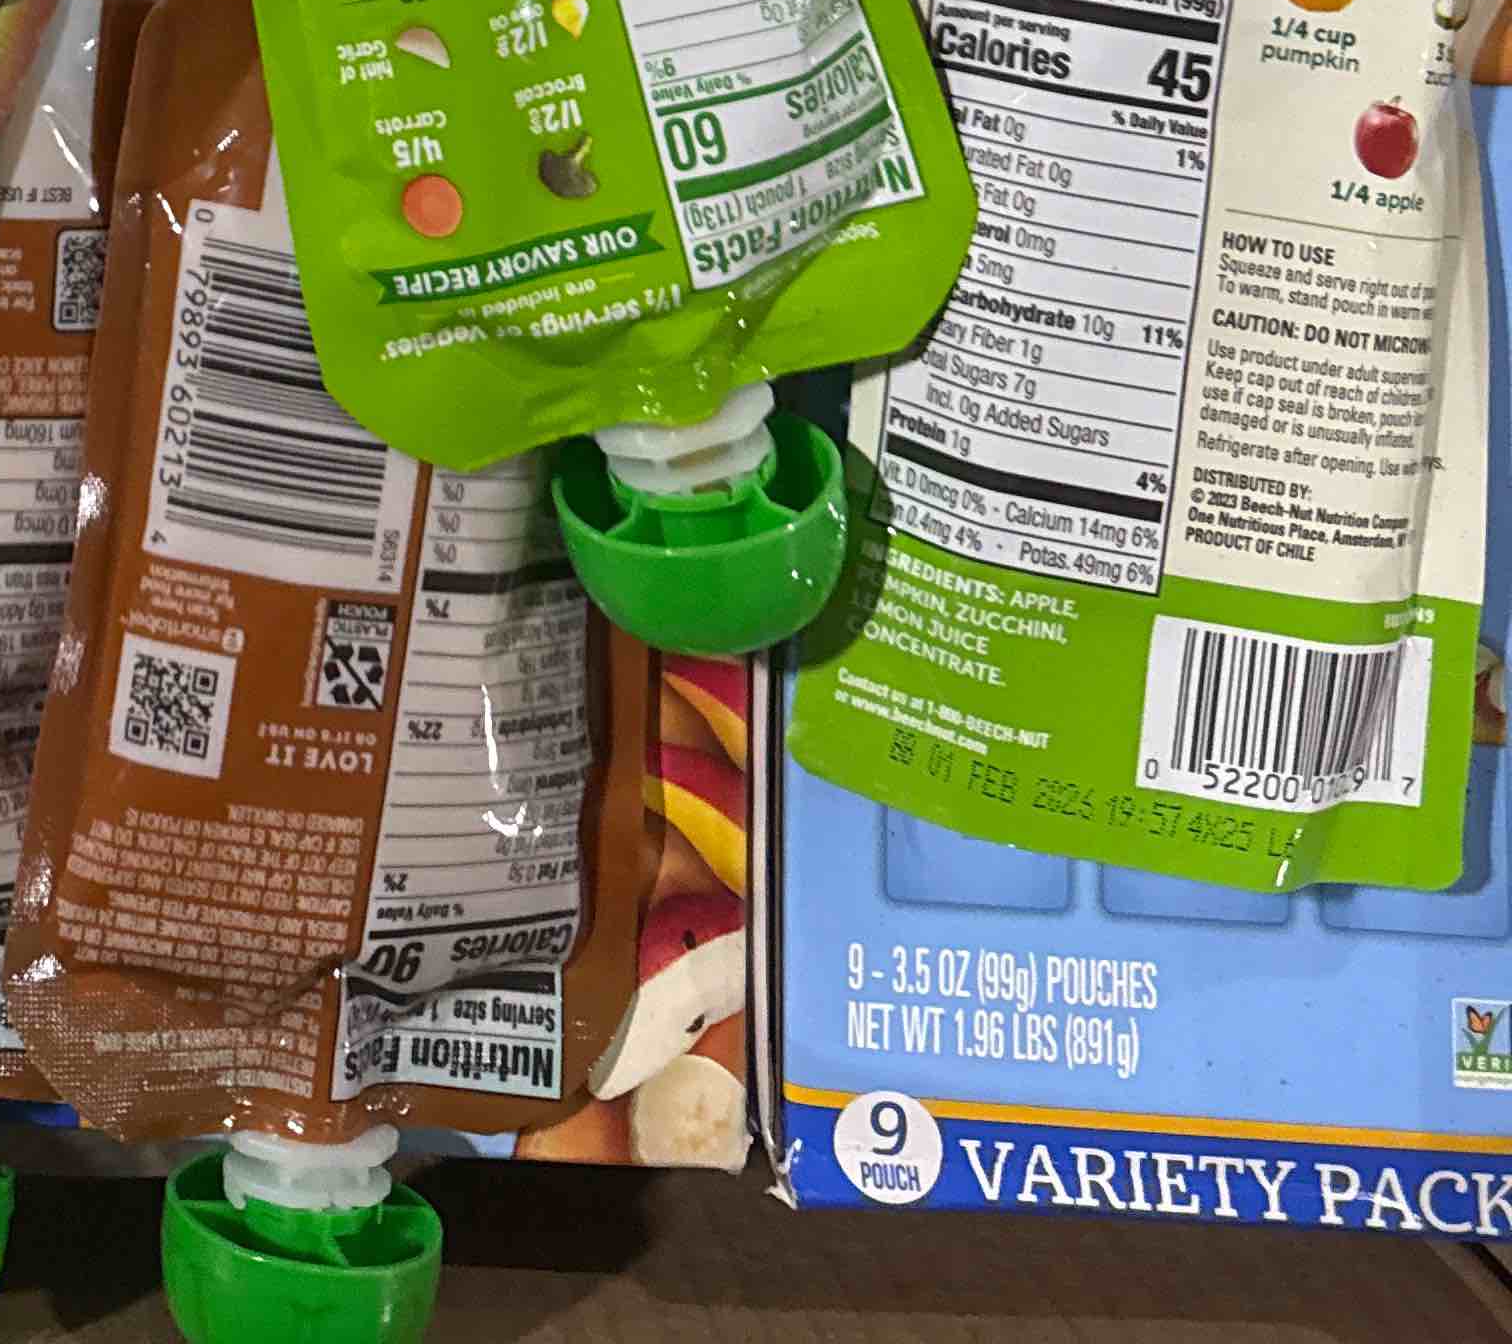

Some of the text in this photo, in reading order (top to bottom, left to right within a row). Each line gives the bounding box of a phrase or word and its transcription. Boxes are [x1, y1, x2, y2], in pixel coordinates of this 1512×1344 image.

[1260, 41, 1361, 74] pumpkin
[1271, 16, 1357, 52] 1/4 cup
[933, 22, 1214, 104] Calories 45
[660, 109, 729, 173] 60
[1330, 180, 1424, 215] 1/4 apple
[391, 223, 637, 300] OUR SAVORY RECIPE
[1221, 232, 1337, 267] HOW TO USE
[162, 384, 195, 487] 60213
[263, 742, 374, 775] LOVE IT
[847, 944, 1156, 1010] 9 3.5 OZ (99g) POUCHES
[407, 1030, 553, 1087] Nutrition
[848, 1002, 1139, 1077] NET WT 1.96 LBS (891g)
[869, 1101, 908, 1154] 9
[860, 1163, 920, 1192] POUCH
[960, 1139, 1512, 1236] VARIETY PACK
